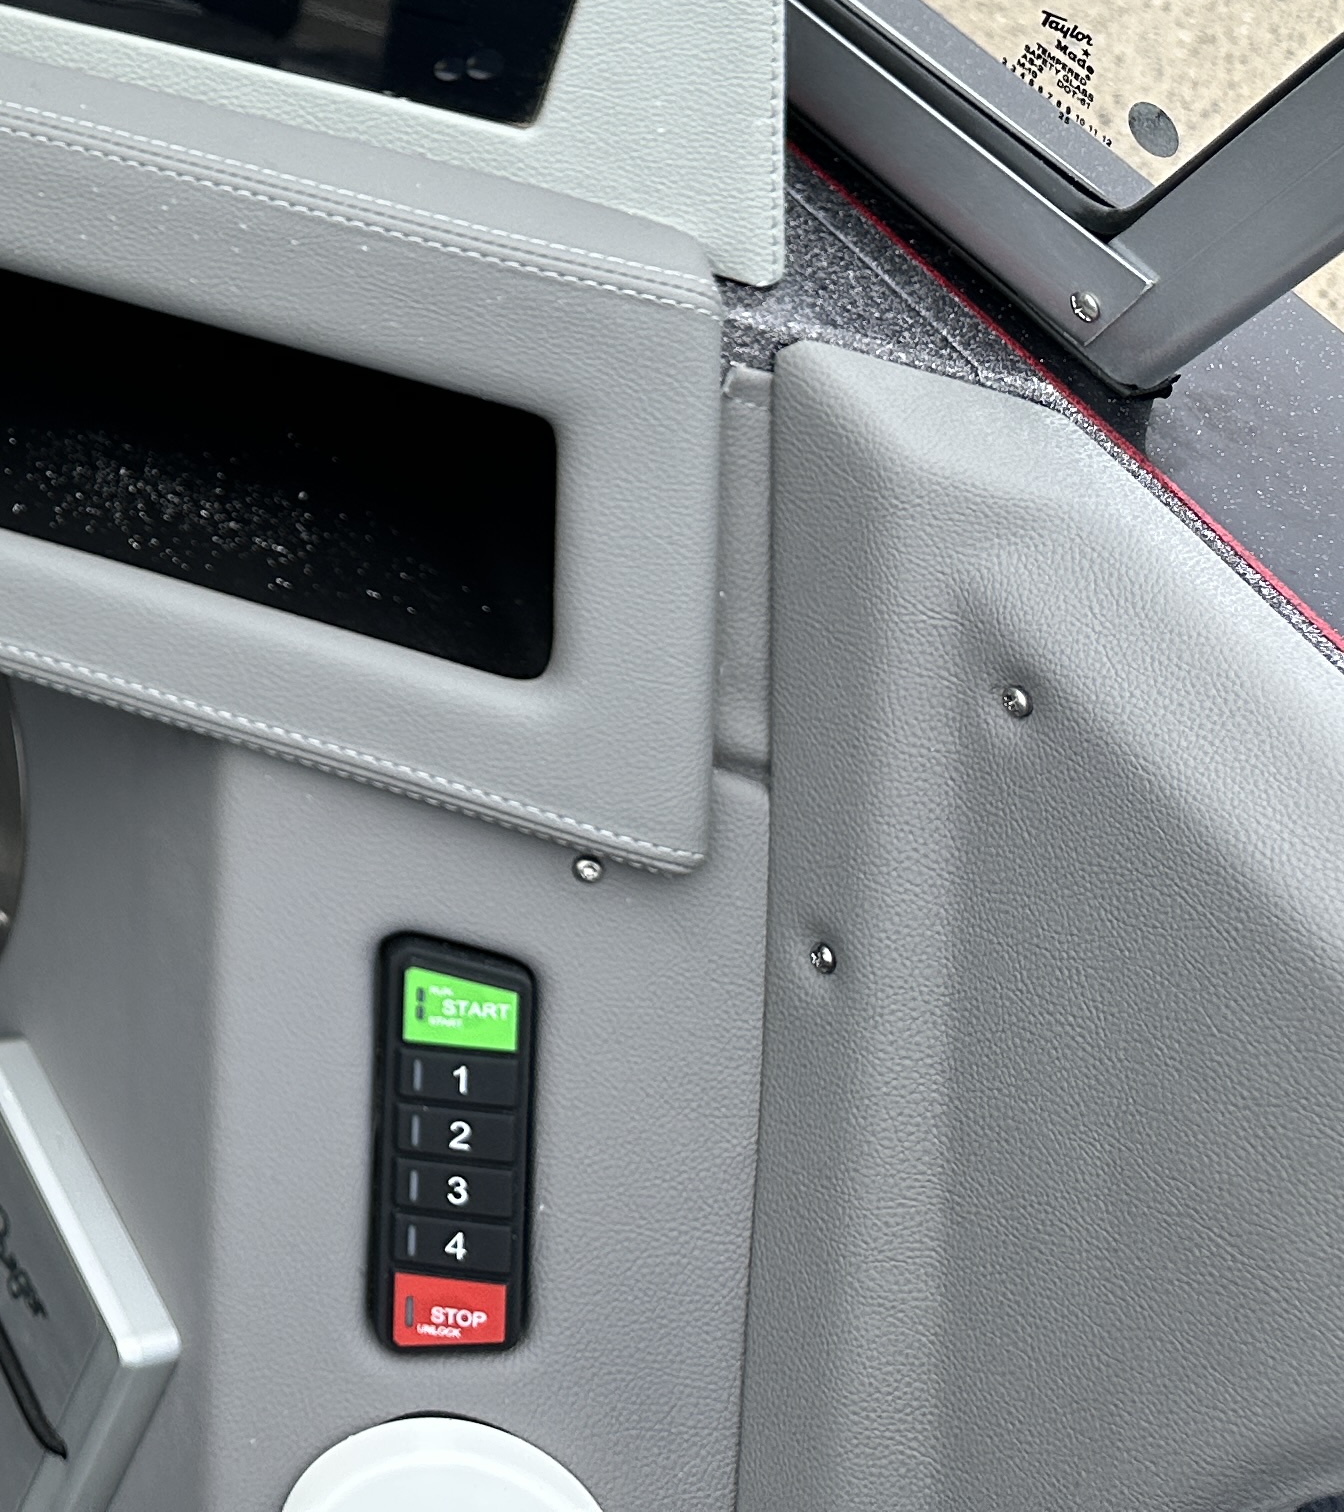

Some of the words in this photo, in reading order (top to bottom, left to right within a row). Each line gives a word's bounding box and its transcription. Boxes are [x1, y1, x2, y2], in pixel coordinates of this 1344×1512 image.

[1041, 9, 1093, 47] Taylor
[1036, 41, 1087, 86] TEMPERED
[1054, 38, 1095, 75] Made
[1024, 44, 1061, 75] SAFETY
[1062, 74, 1094, 103] GLASS
[1102, 135, 1113, 148] 12
[441, 998, 511, 1021] START
[452, 1065, 469, 1095] 1
[448, 1120, 472, 1152] 2
[446, 1175, 469, 1206] 3
[444, 1231, 467, 1260] 4
[430, 1305, 488, 1328] STOP
